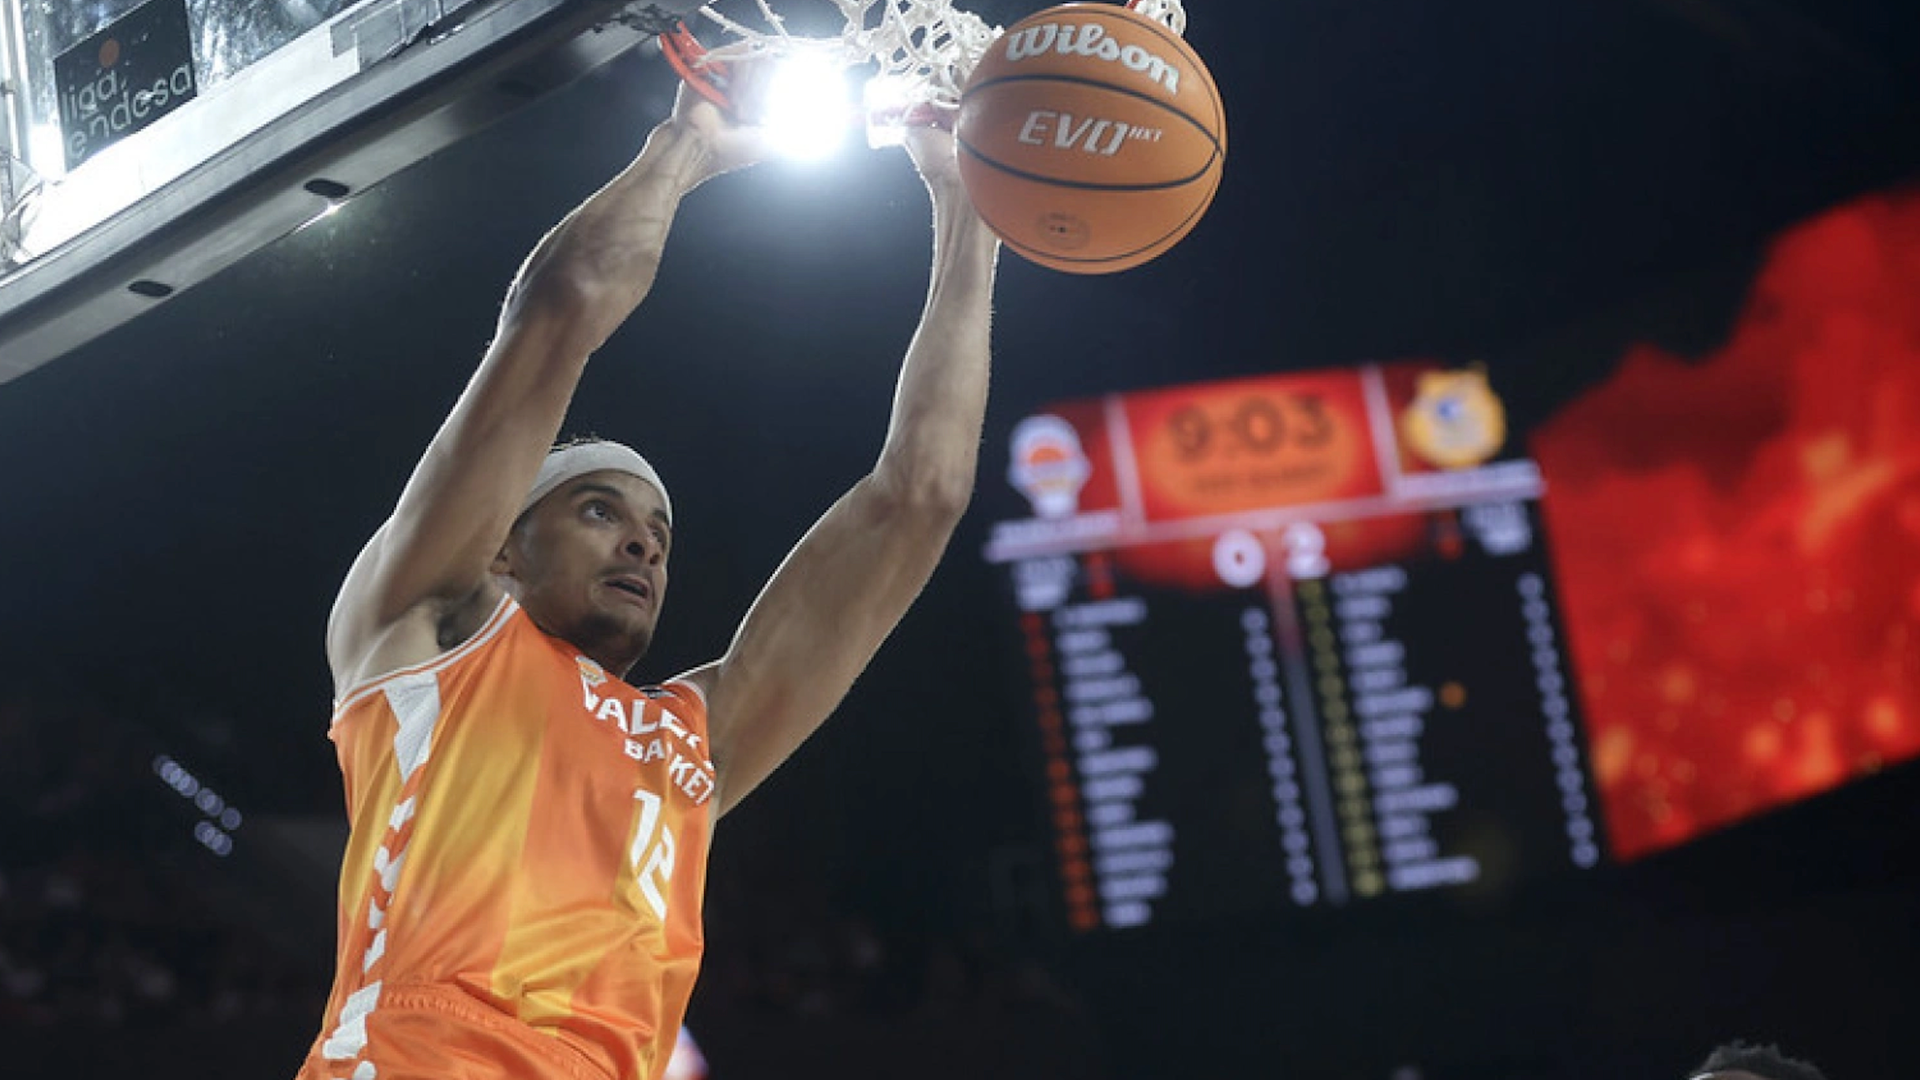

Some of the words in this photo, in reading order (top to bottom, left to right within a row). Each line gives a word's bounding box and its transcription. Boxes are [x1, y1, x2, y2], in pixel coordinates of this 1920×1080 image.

[1006, 23, 1180, 95] Wilson
[62, 68, 118, 123] liga
[69, 64, 193, 159] endesa
[624, 738, 715, 805] BAKET
[630, 789, 676, 923] 12
